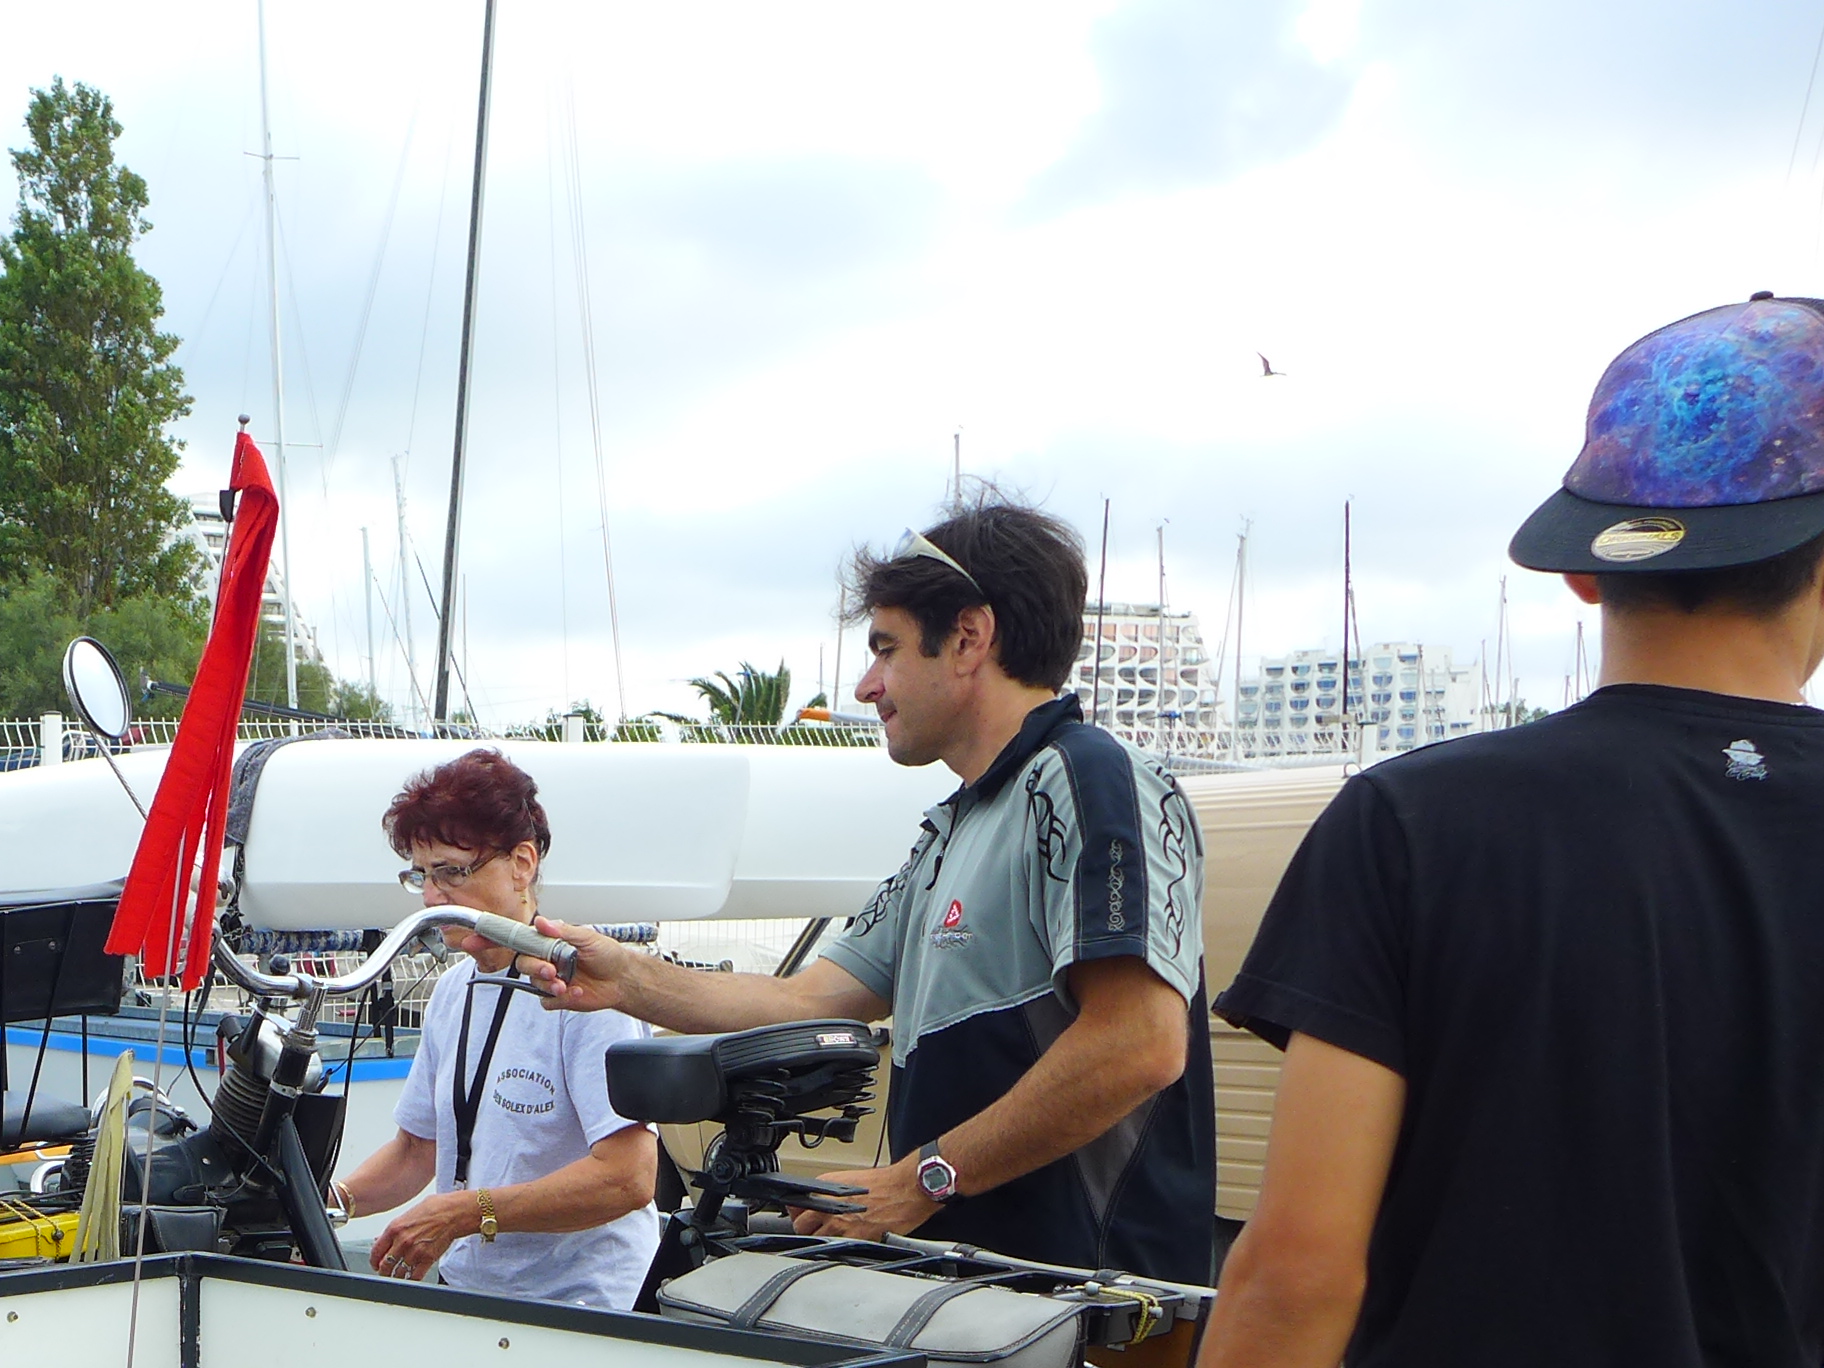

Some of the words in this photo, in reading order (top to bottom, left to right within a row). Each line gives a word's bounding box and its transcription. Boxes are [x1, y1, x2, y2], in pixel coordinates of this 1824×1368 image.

[497, 1068, 556, 1096] ASSOCIATION
[502, 1098, 525, 1114] SOLEX
[526, 1100, 555, 1114] D'ALEX
